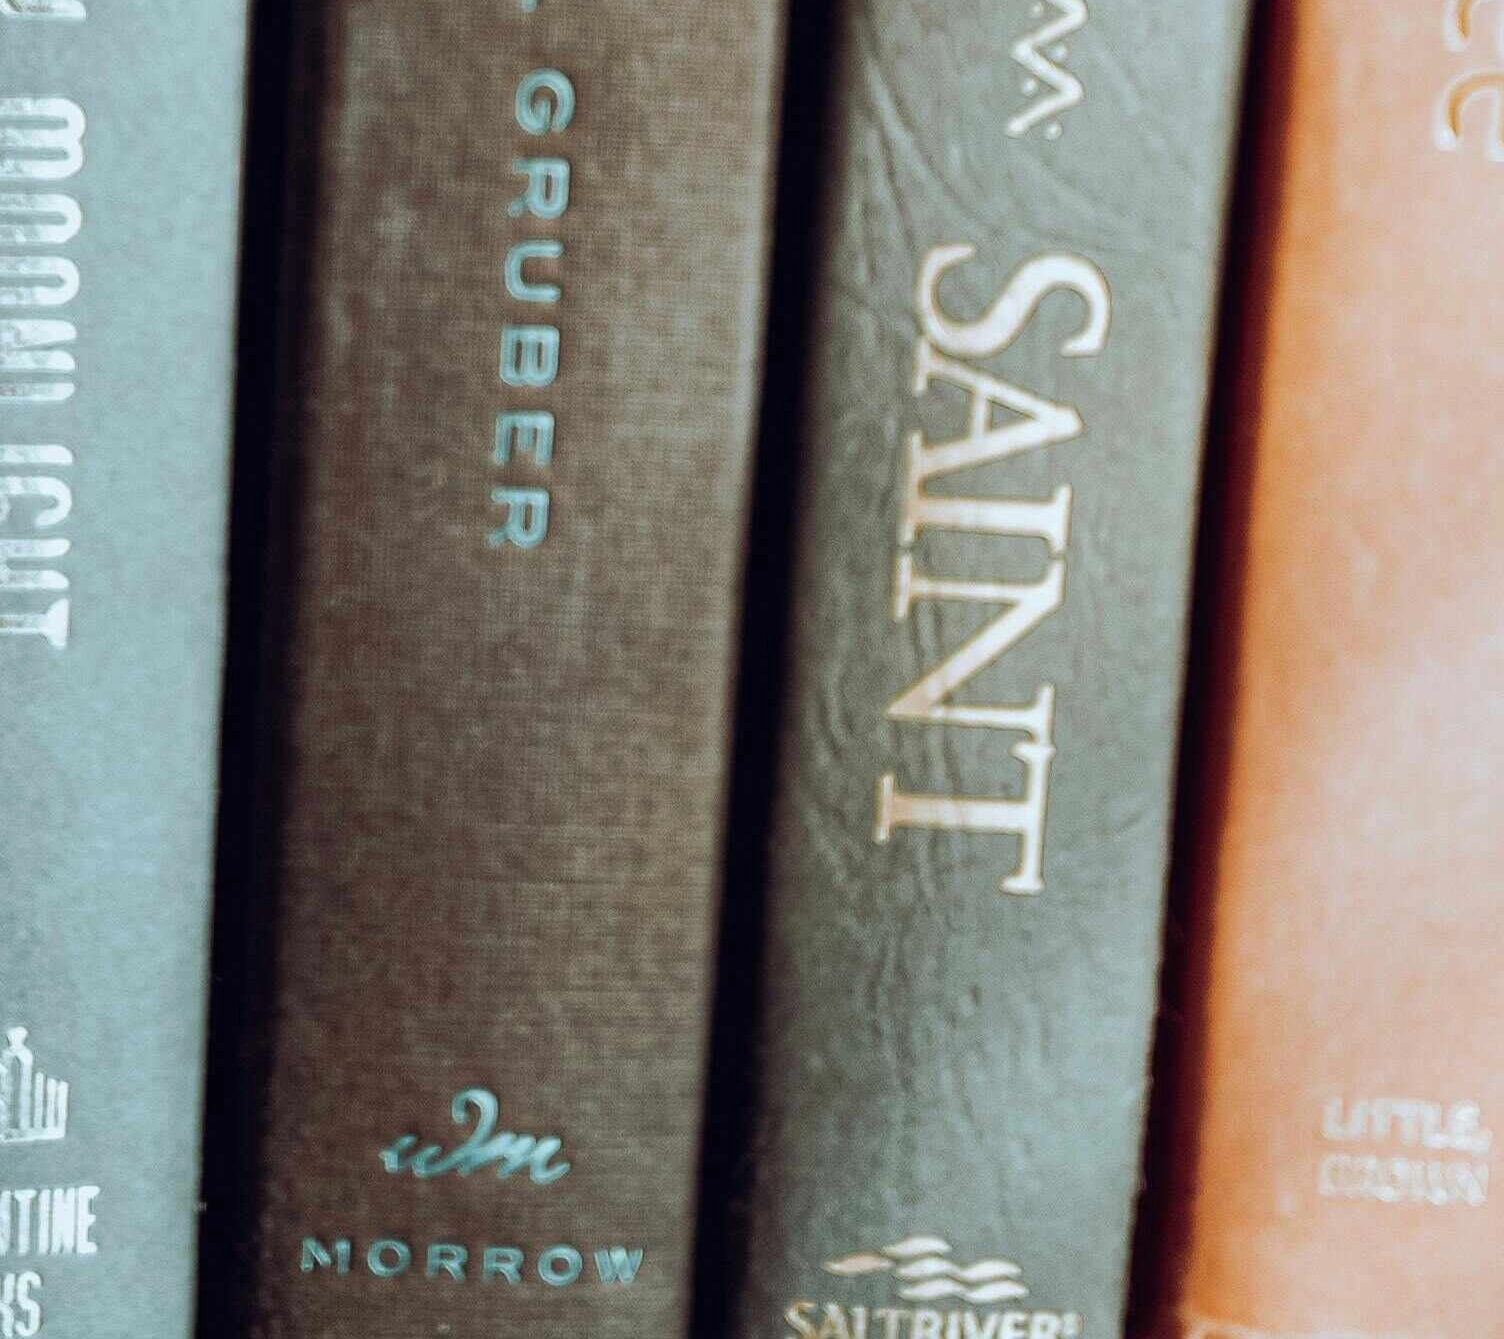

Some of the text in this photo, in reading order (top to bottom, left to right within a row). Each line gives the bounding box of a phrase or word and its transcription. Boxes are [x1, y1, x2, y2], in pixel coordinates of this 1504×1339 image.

[487, 66, 576, 548] GRUBER
[875, 241, 1111, 897] SAINT
[300, 1236, 644, 1287] MORROW
